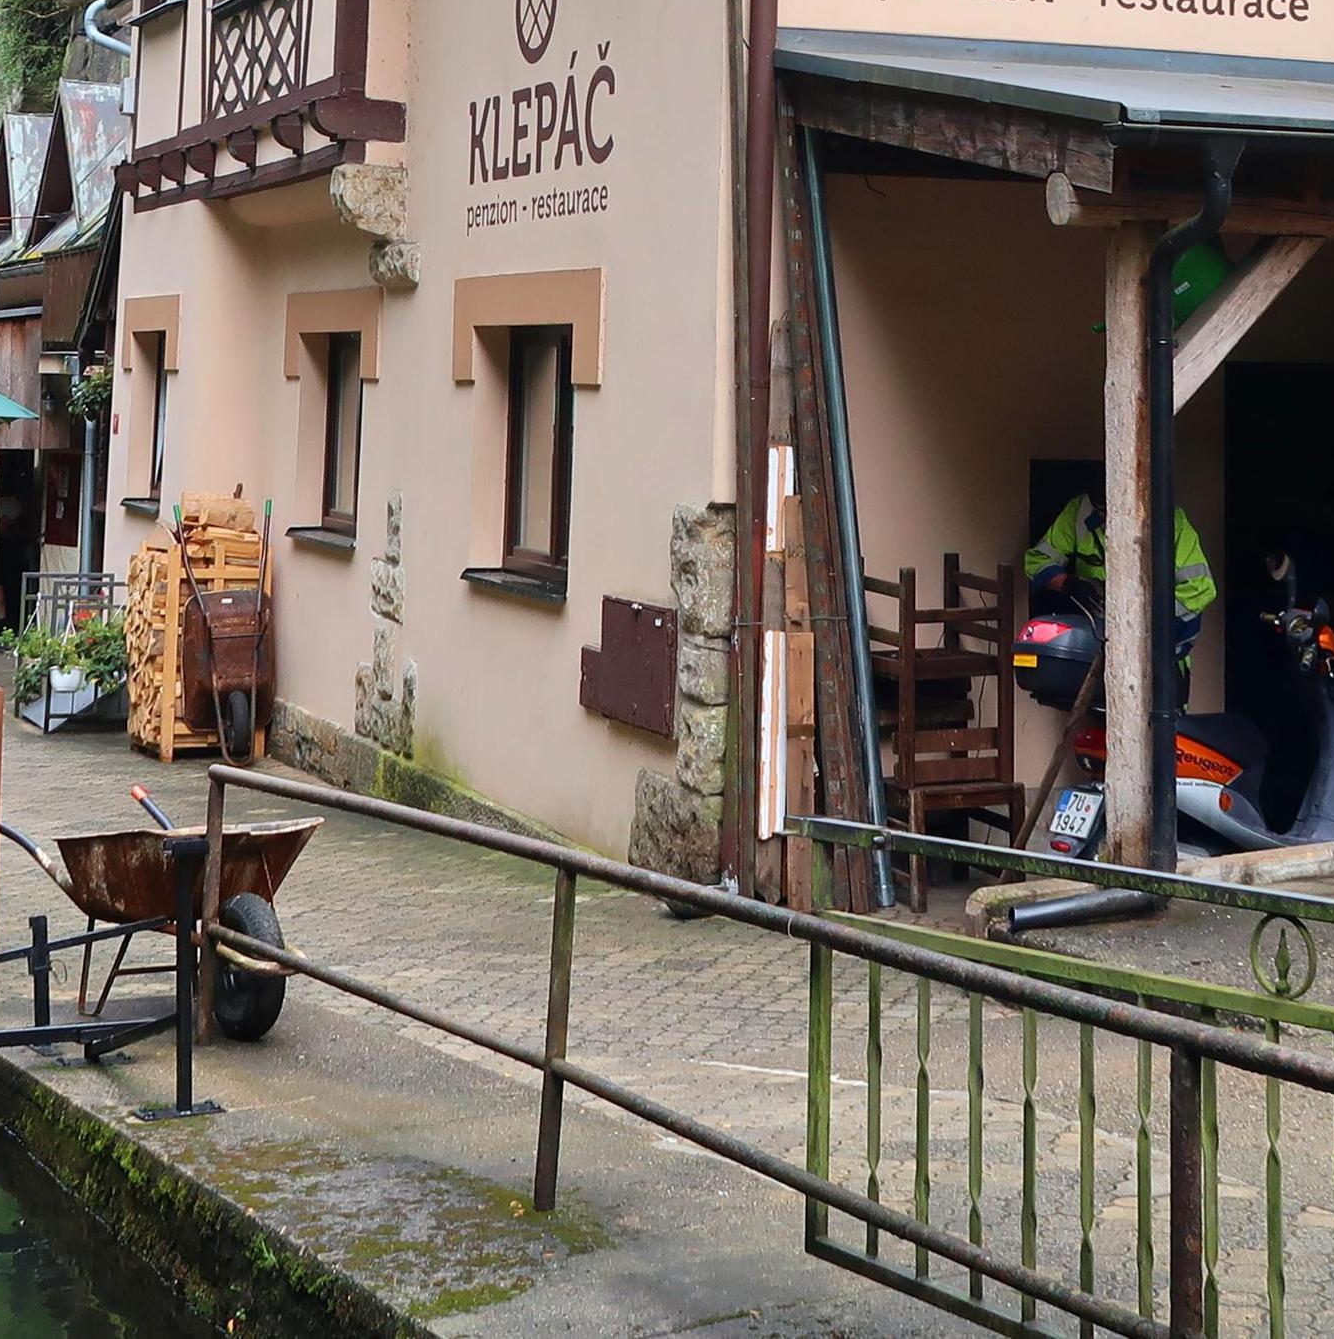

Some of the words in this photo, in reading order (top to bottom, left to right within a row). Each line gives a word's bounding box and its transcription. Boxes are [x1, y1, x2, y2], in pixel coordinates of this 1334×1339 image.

[468, 40, 616, 186] KLEPÁČ
[466, 193, 517, 237] penzion
[531, 184, 609, 220] restaurace
